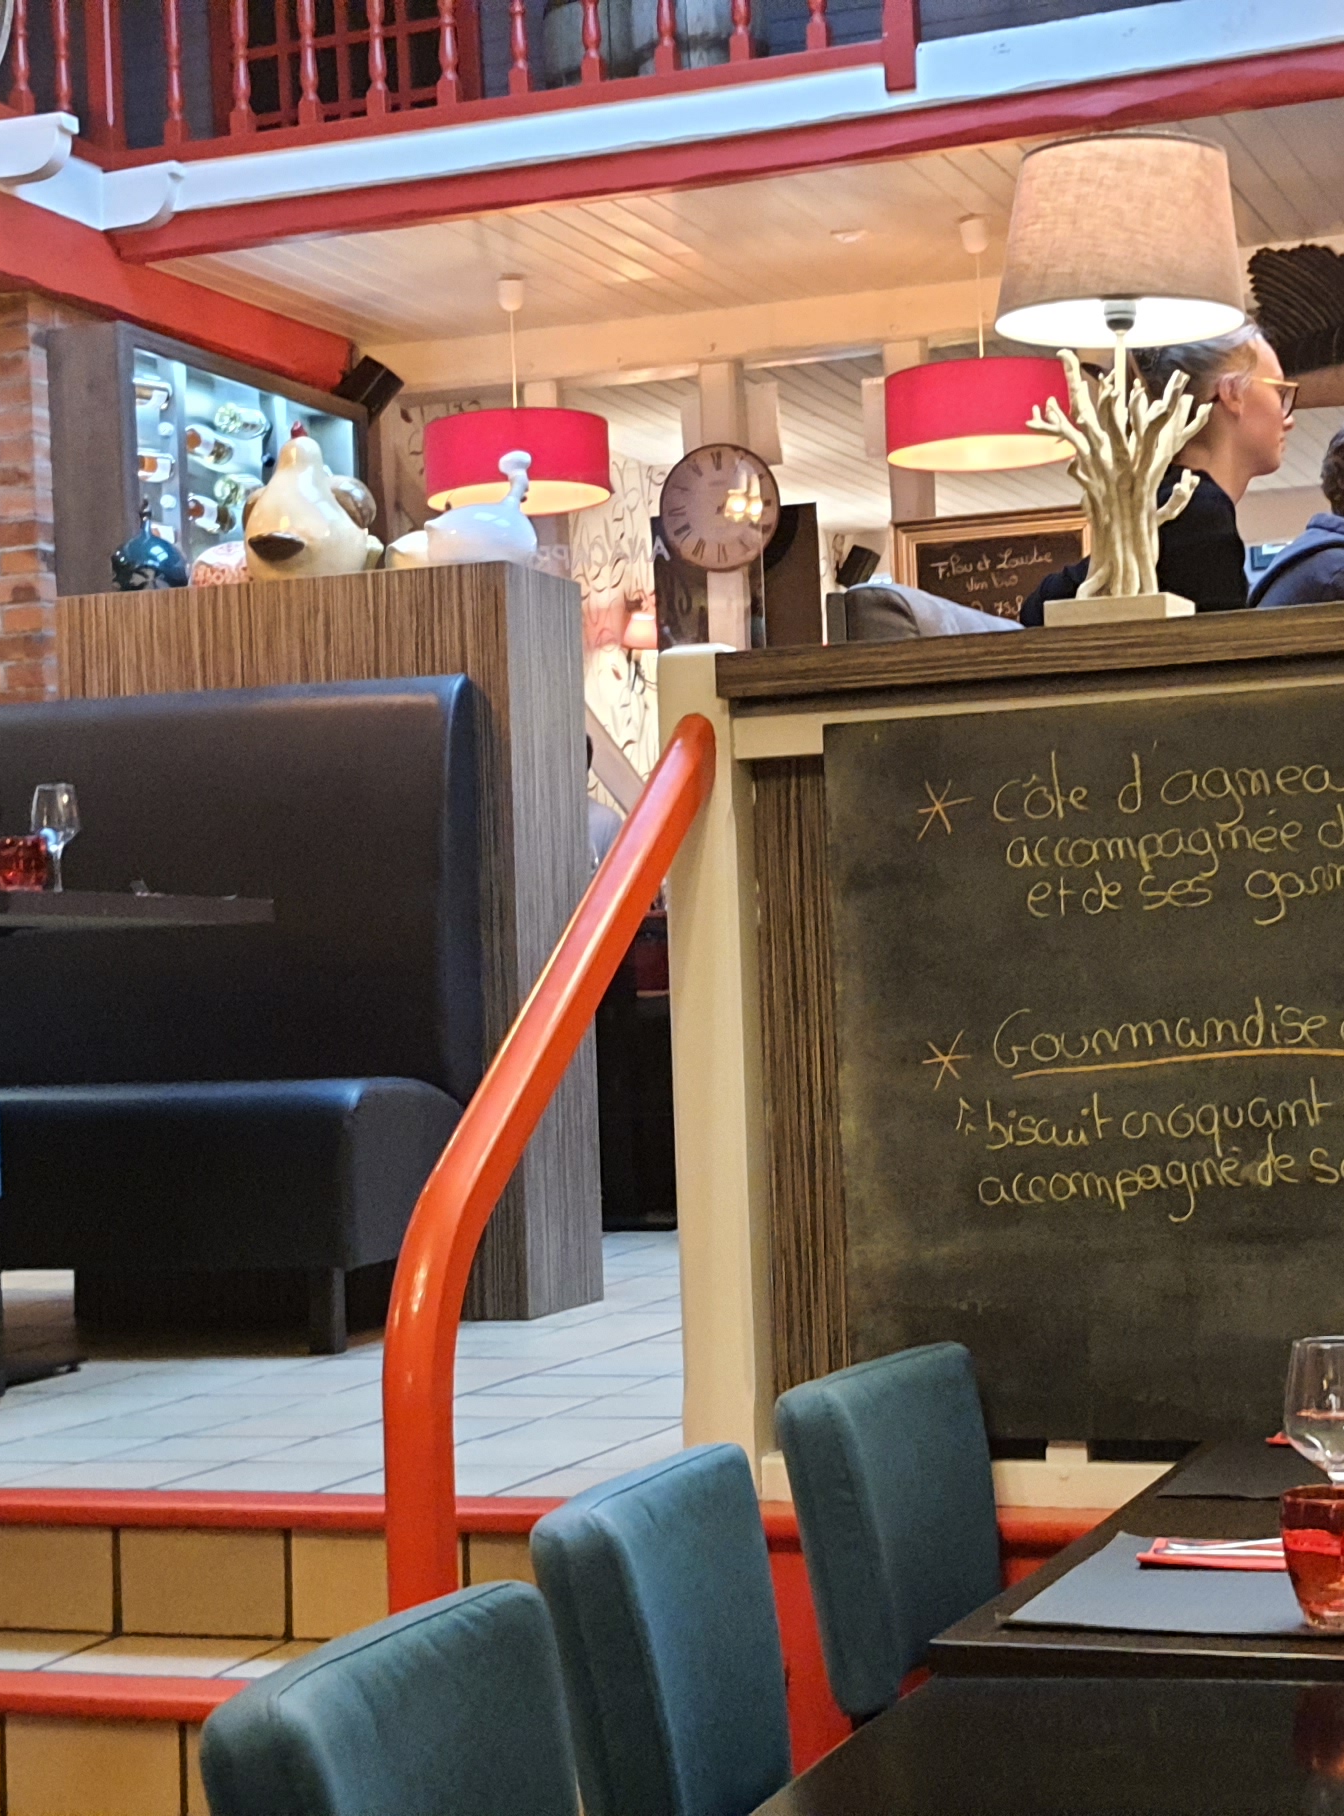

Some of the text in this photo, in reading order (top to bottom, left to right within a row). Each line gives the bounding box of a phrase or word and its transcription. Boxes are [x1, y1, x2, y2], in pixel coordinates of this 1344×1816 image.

[1026, 876, 1076, 919] et
[1081, 870, 1124, 916] de
[1137, 873, 1214, 911] ses
[993, 996, 1329, 1069] Gourmandise
[986, 1092, 1113, 1151] biscuit
[1122, 1077, 1333, 1158] croquant
[1257, 1132, 1300, 1188] de
